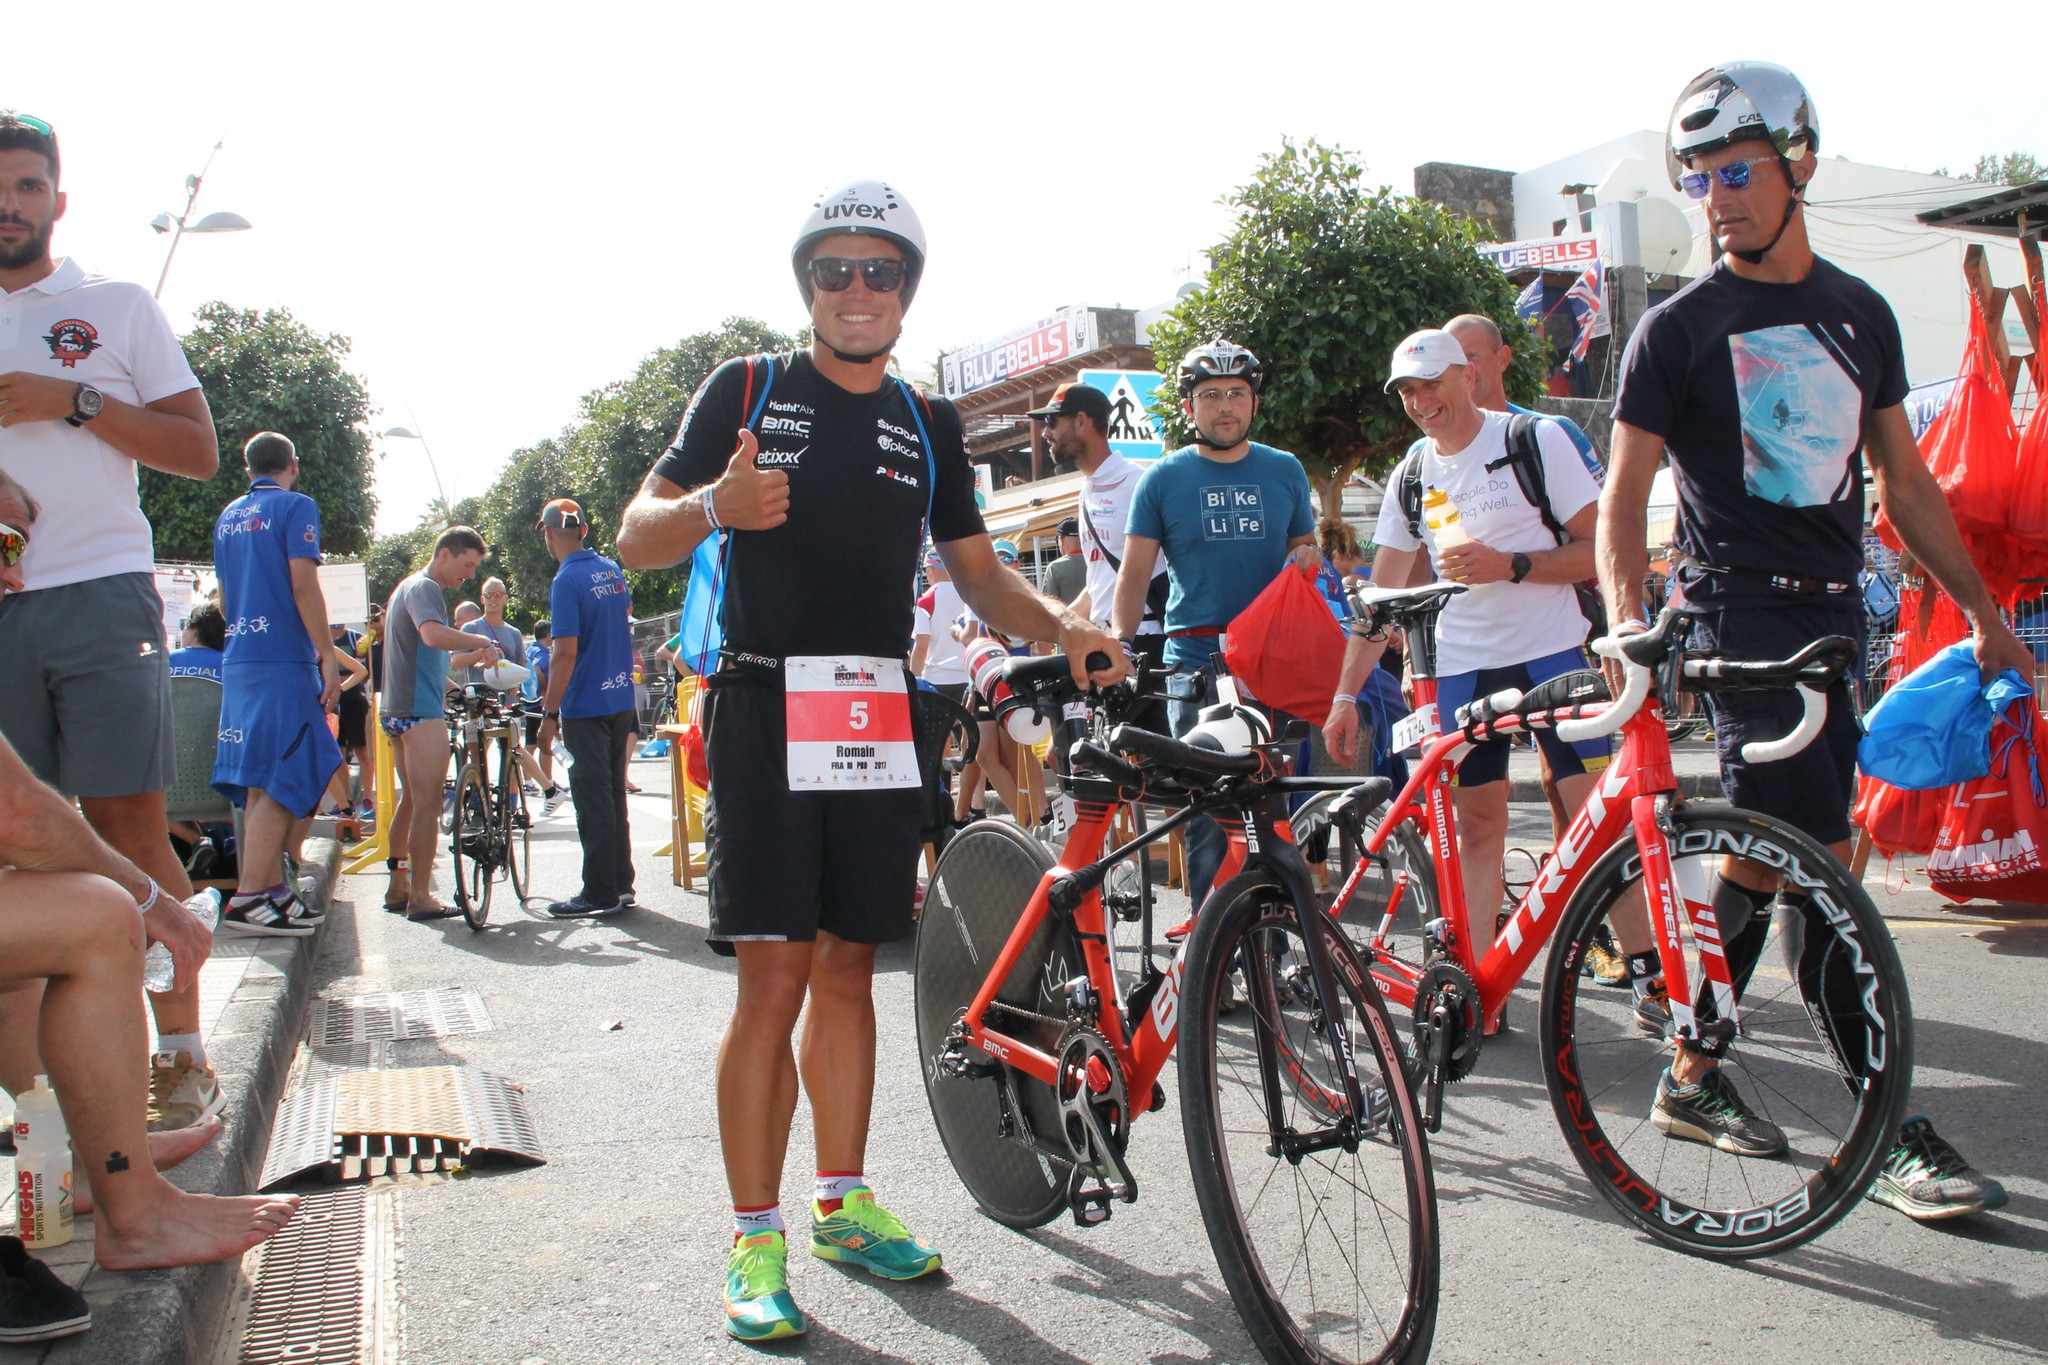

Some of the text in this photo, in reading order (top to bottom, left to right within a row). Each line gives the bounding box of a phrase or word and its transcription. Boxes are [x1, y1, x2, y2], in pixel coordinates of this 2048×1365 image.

[824, 203, 887, 222] uvex
[1492, 241, 1593, 269] UEBELLS
[963, 325, 1063, 390] BLUEBELLS
[761, 415, 812, 433] BMC
[876, 466, 919, 488] POLAR
[1488, 480, 1509, 492] Do
[1207, 491, 1258, 507] Bi Ke
[1211, 517, 1260, 533] Li Fe
[591, 569, 619, 584] OFCIAL
[849, 701, 869, 730] 5
[831, 761, 844, 770] FRA
[836, 745, 875, 758] Romain
[1058, 811, 1066, 831] 5
[1241, 810, 1260, 854] BMC
[1432, 788, 1450, 860] SHIMANO
[1494, 752, 1630, 956] TREK
[1930, 850, 2038, 878] ANZAROTE
[1331, 865, 1363, 910] TREK
[1659, 878, 1679, 951] TREK
[983, 1037, 1009, 1060] BMC
[1335, 1022, 1357, 1078] BMC
[1556, 1041, 1659, 1211] ULTRA
[18, 1170, 36, 1241] HIGH5
[35, 1173, 45, 1241] SPORTS NUTRITION
[1658, 1184, 1813, 1237] BORA
